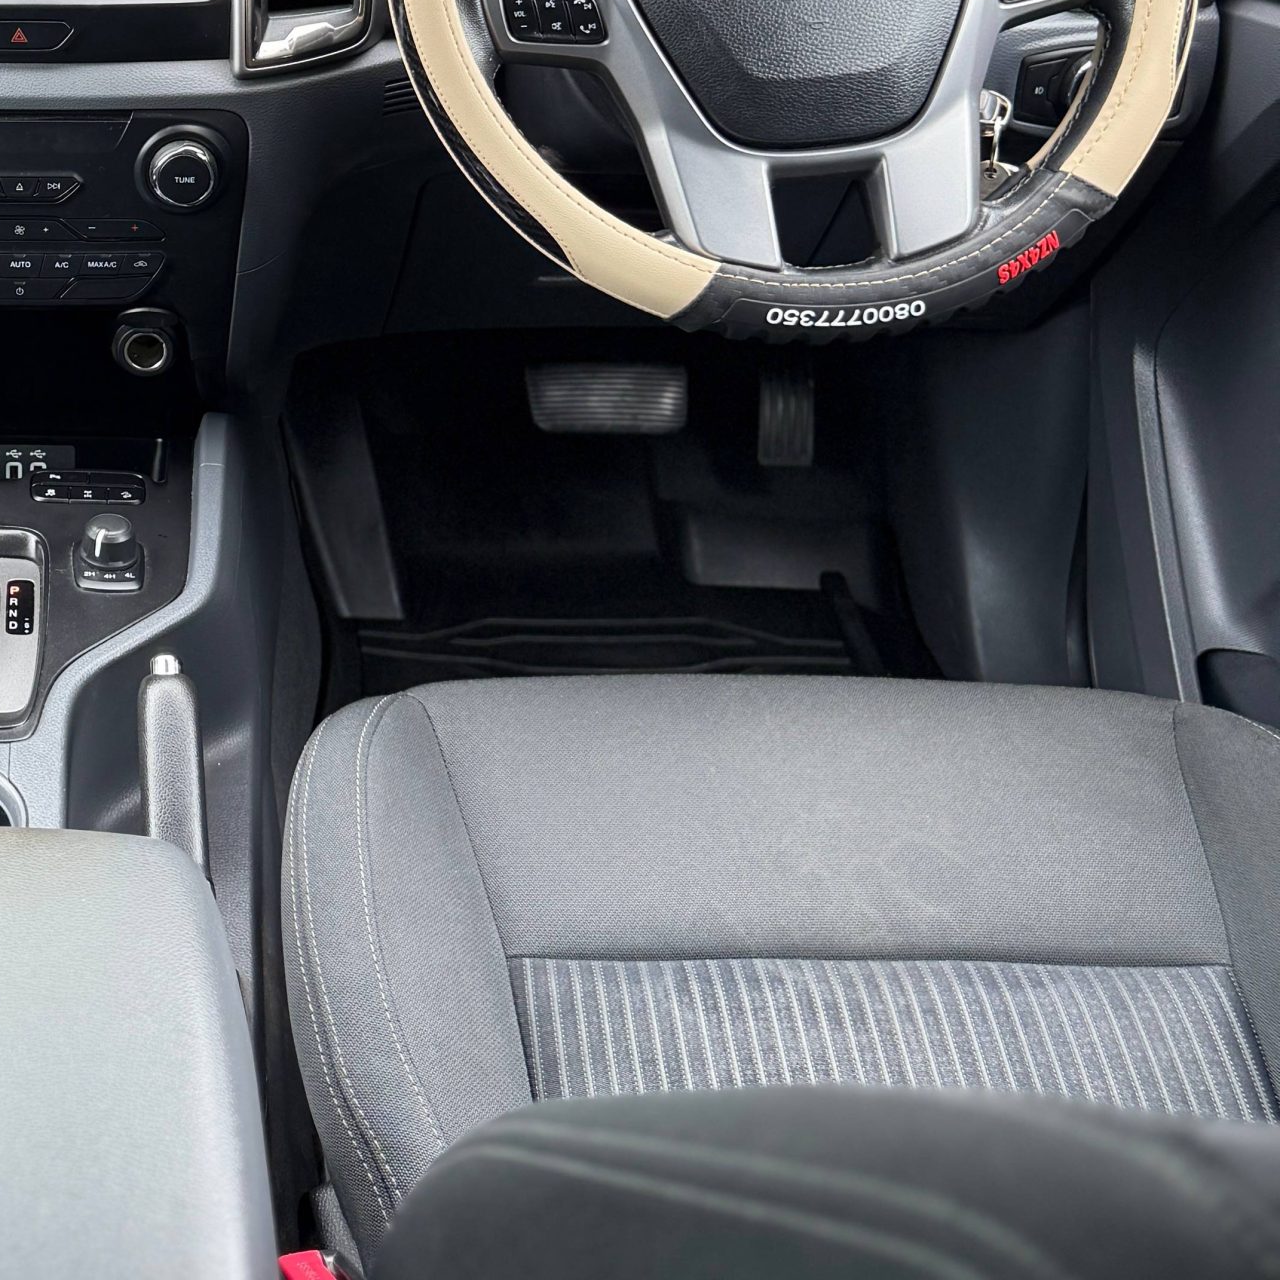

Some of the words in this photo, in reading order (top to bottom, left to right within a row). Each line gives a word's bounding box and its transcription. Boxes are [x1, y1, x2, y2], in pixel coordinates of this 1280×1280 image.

[998, 230, 1060, 285] NZ4X4S
[766, 300, 926, 326] 0800777350
[10, 586, 20, 595] P
[9, 597, 18, 606] R
[9, 609, 18, 618] N
[8, 620, 18, 630] D
